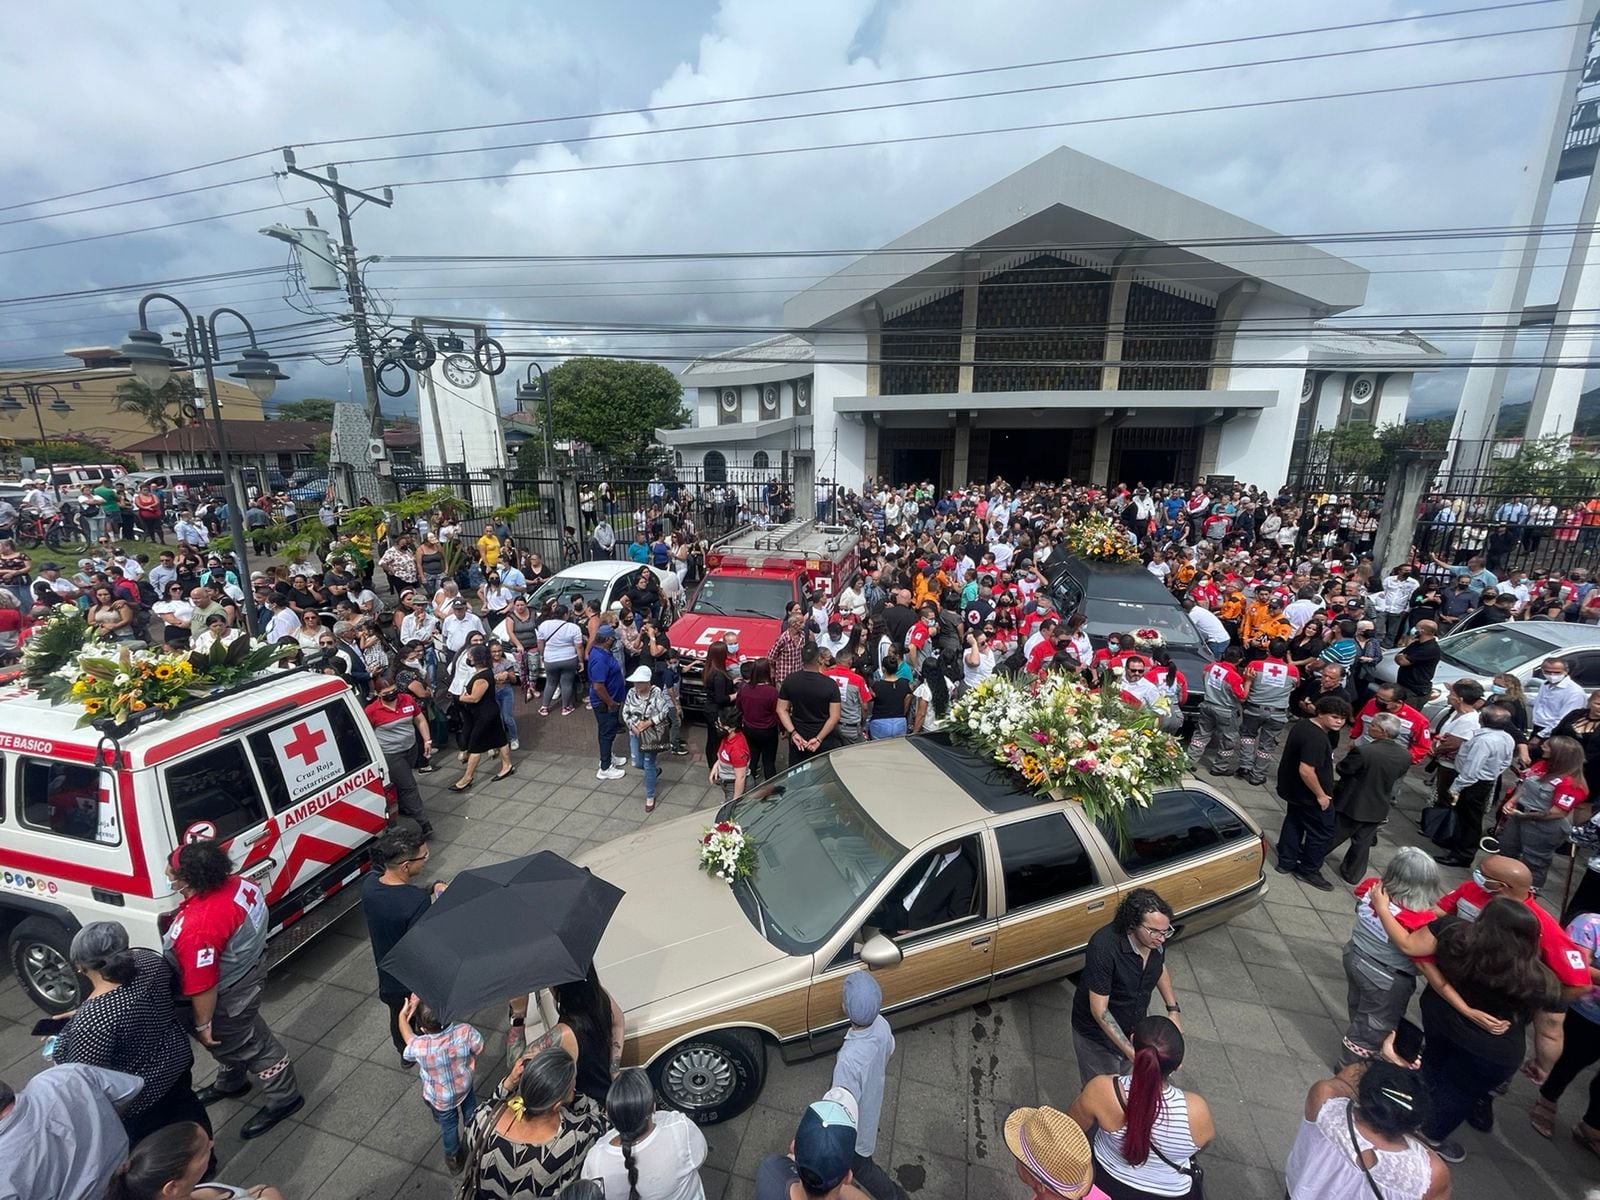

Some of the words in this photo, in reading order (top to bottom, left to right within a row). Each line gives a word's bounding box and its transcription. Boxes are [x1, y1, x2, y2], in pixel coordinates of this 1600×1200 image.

[13, 736, 53, 754] BASICO
[292, 767, 342, 796] Costarricense
[295, 770, 316, 783] Cruz
[316, 760, 334, 773] Roja
[284, 768, 376, 829] AMBULANCIA
